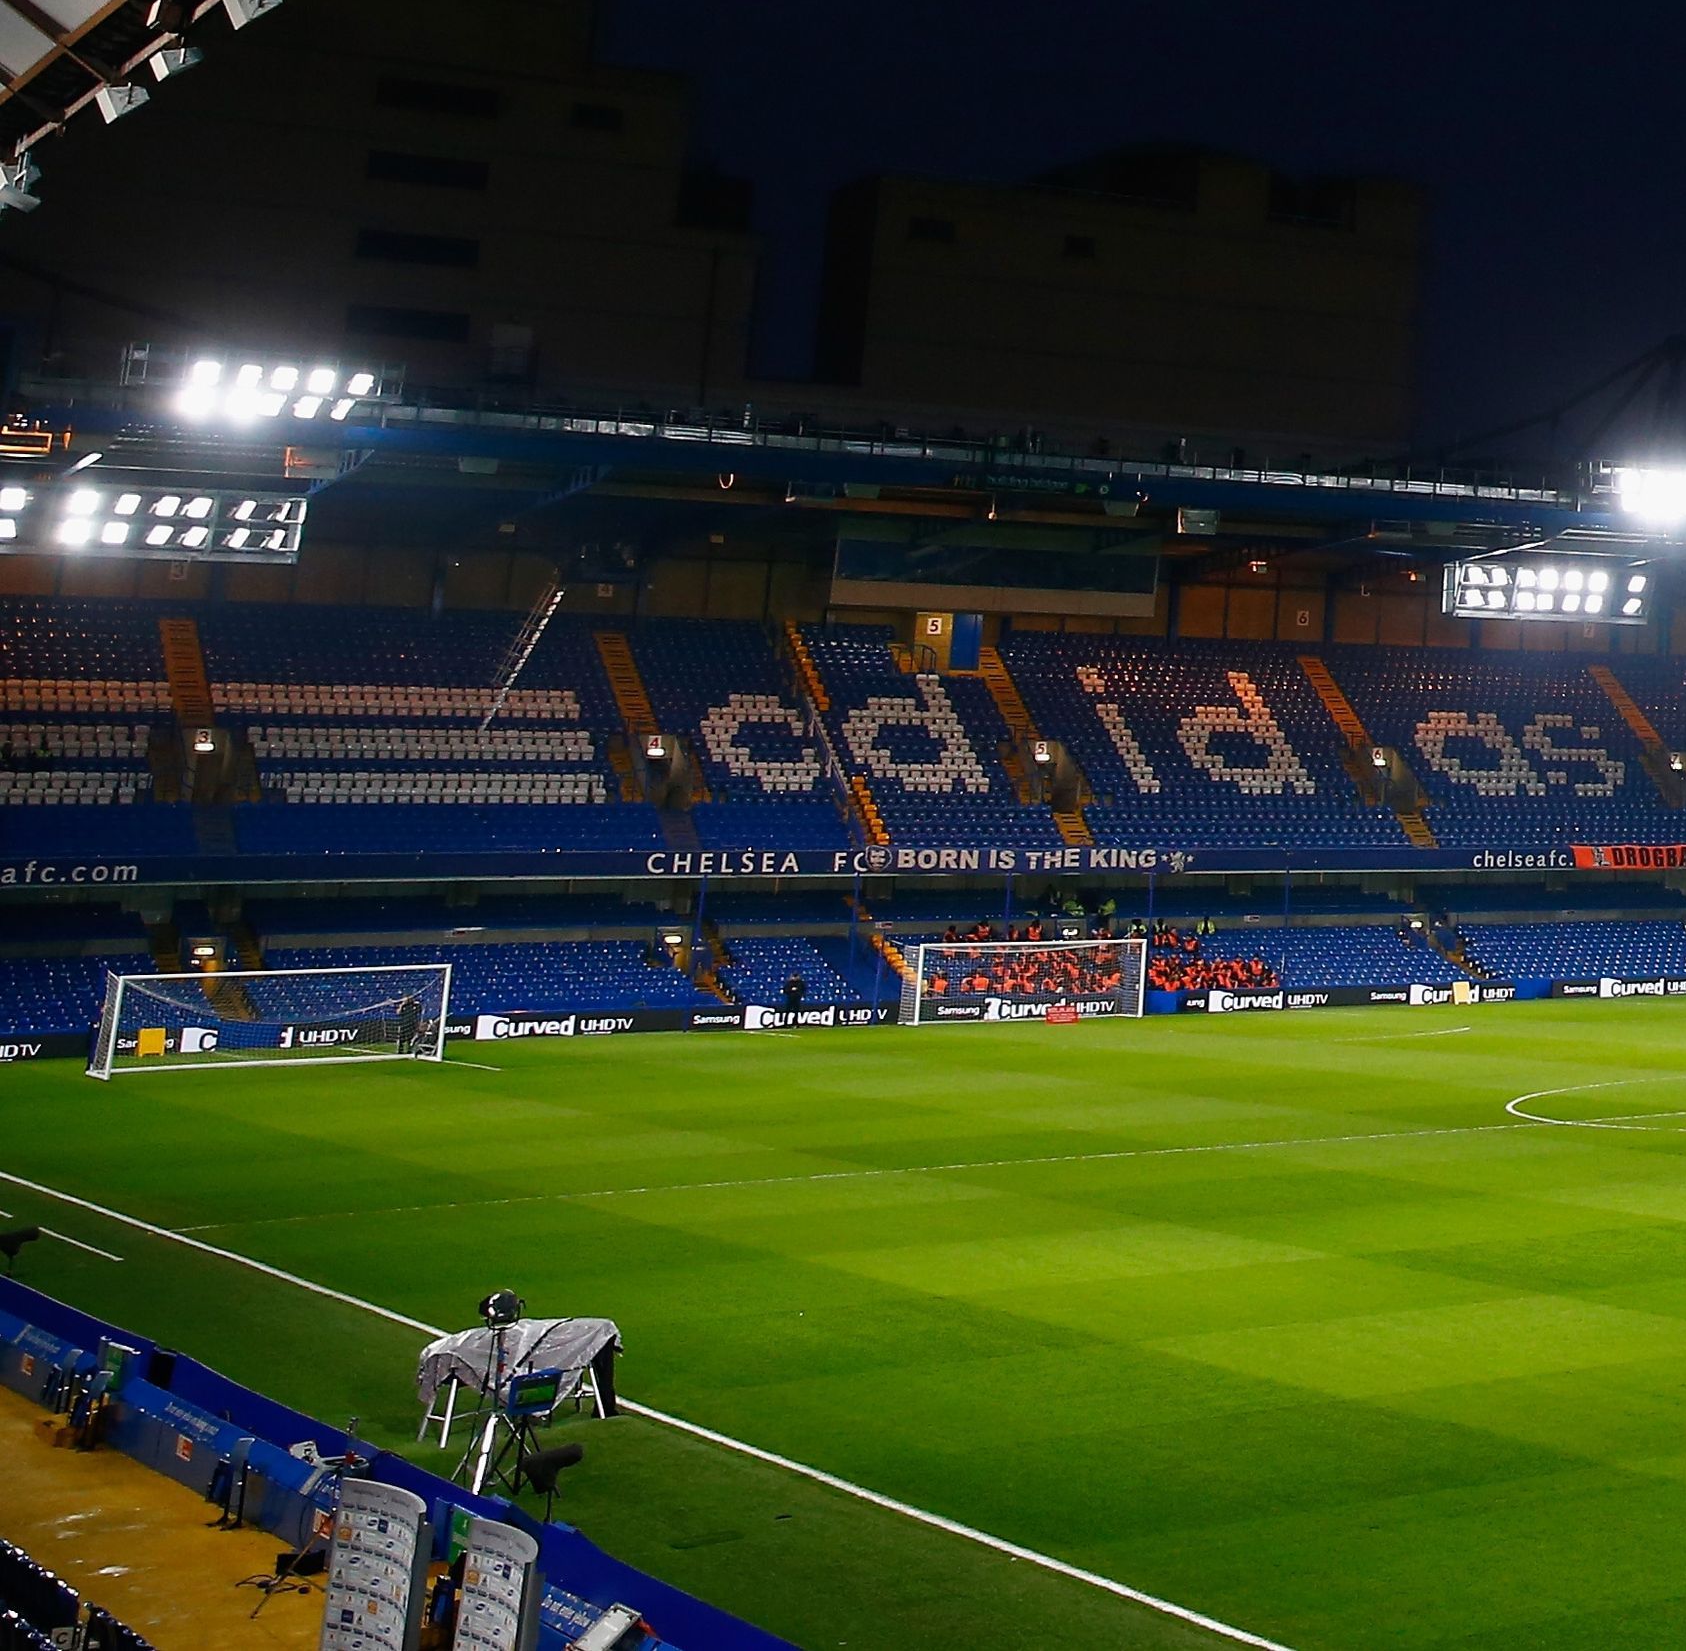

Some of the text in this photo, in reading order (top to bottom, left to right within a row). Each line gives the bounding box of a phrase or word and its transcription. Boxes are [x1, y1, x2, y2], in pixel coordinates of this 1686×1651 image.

[1299, 612, 1307, 624] 6
[929, 620, 939, 632] 5
[198, 731, 209, 743] 3
[649, 737, 660, 748] 4
[1037, 743, 1046, 754] 5
[1374, 749, 1382, 759] 6
[646, 851, 868, 874] CHELSEA FC
[897, 847, 1157, 870] BORN IS THE KING
[1370, 983, 1516, 1005] Samsung Curd UHDT
[1563, 983, 1597, 995] Samsung
[1600, 977, 1665, 998] Curved
[1208, 990, 1284, 1012] Curved
[1287, 993, 1328, 1006] UHDTV
[937, 1003, 980, 1018] Samsung
[444, 1014, 634, 1040] sung Curved UHDTV
[693, 1013, 740, 1028] Samsung
[299, 1029, 358, 1044] UHDTV
[56, 1632, 68, 1644] C
